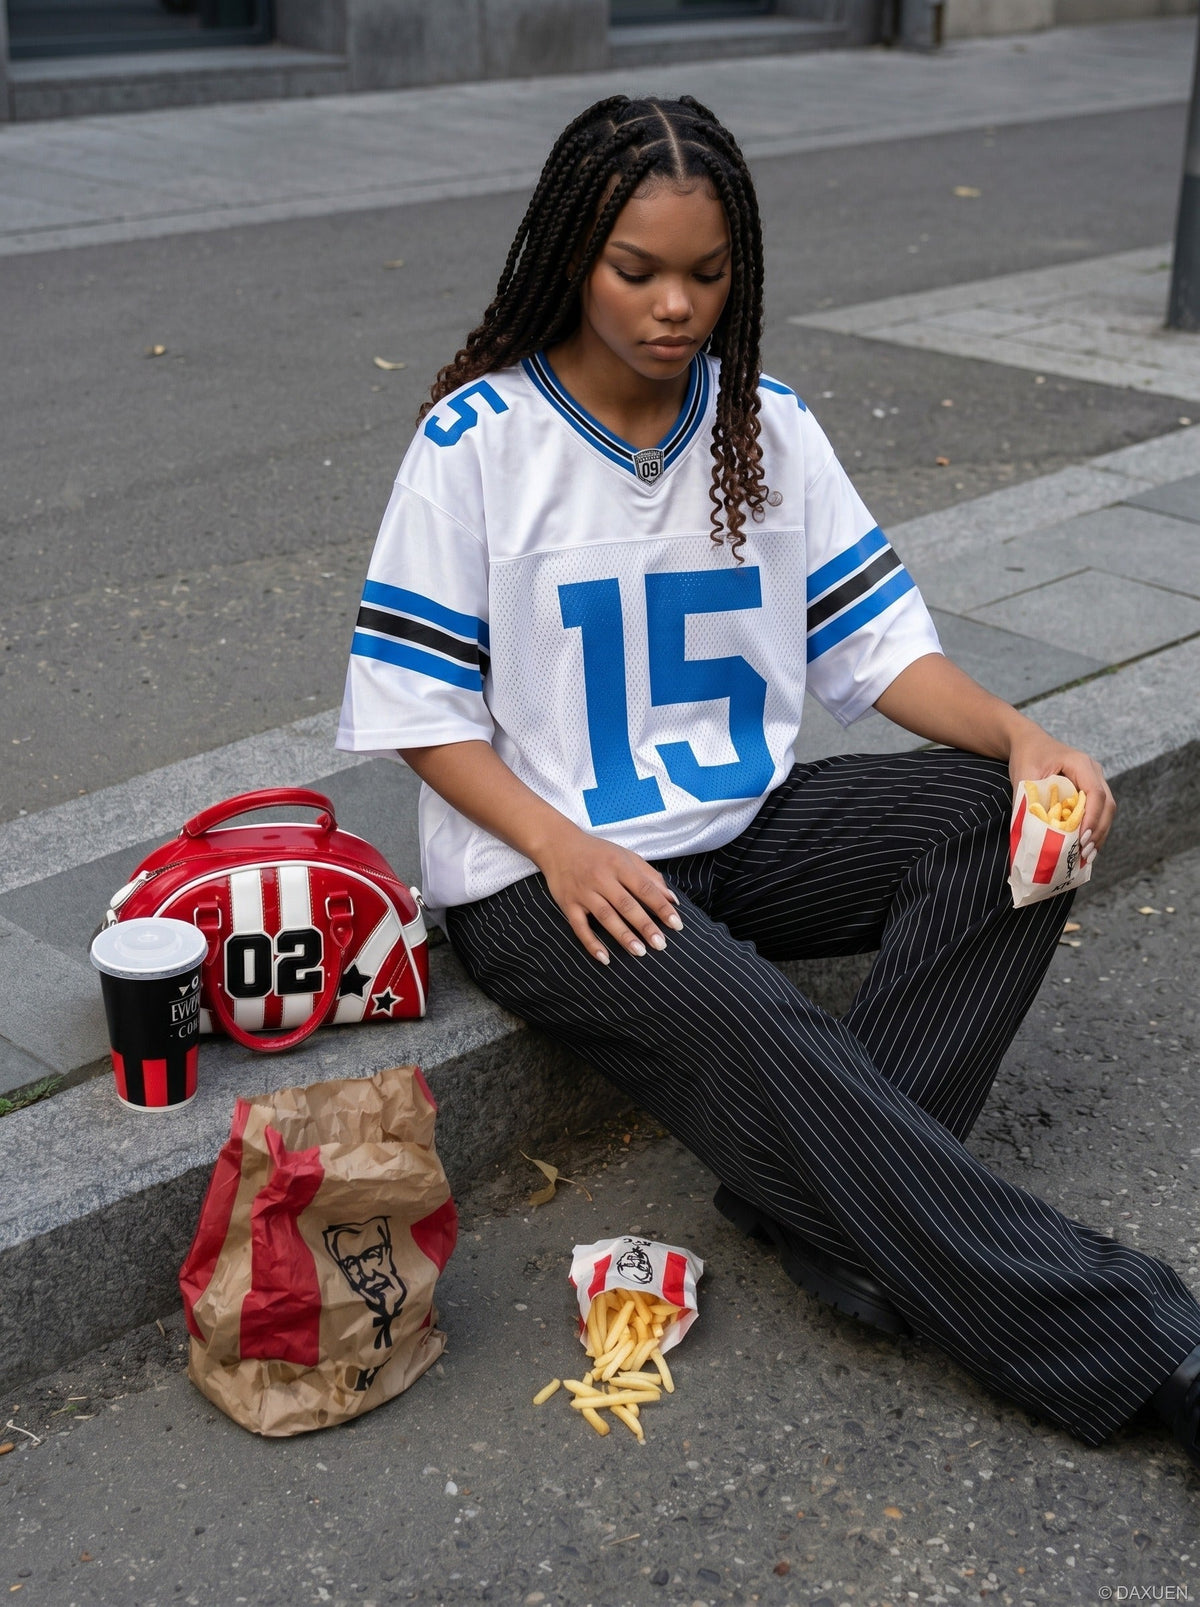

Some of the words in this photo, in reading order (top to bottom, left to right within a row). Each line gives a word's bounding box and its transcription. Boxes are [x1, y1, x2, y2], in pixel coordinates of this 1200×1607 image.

[424, 380, 509, 447] 5
[642, 461, 659, 478] 09
[557, 566, 776, 827] 15
[224, 925, 324, 999] 02
